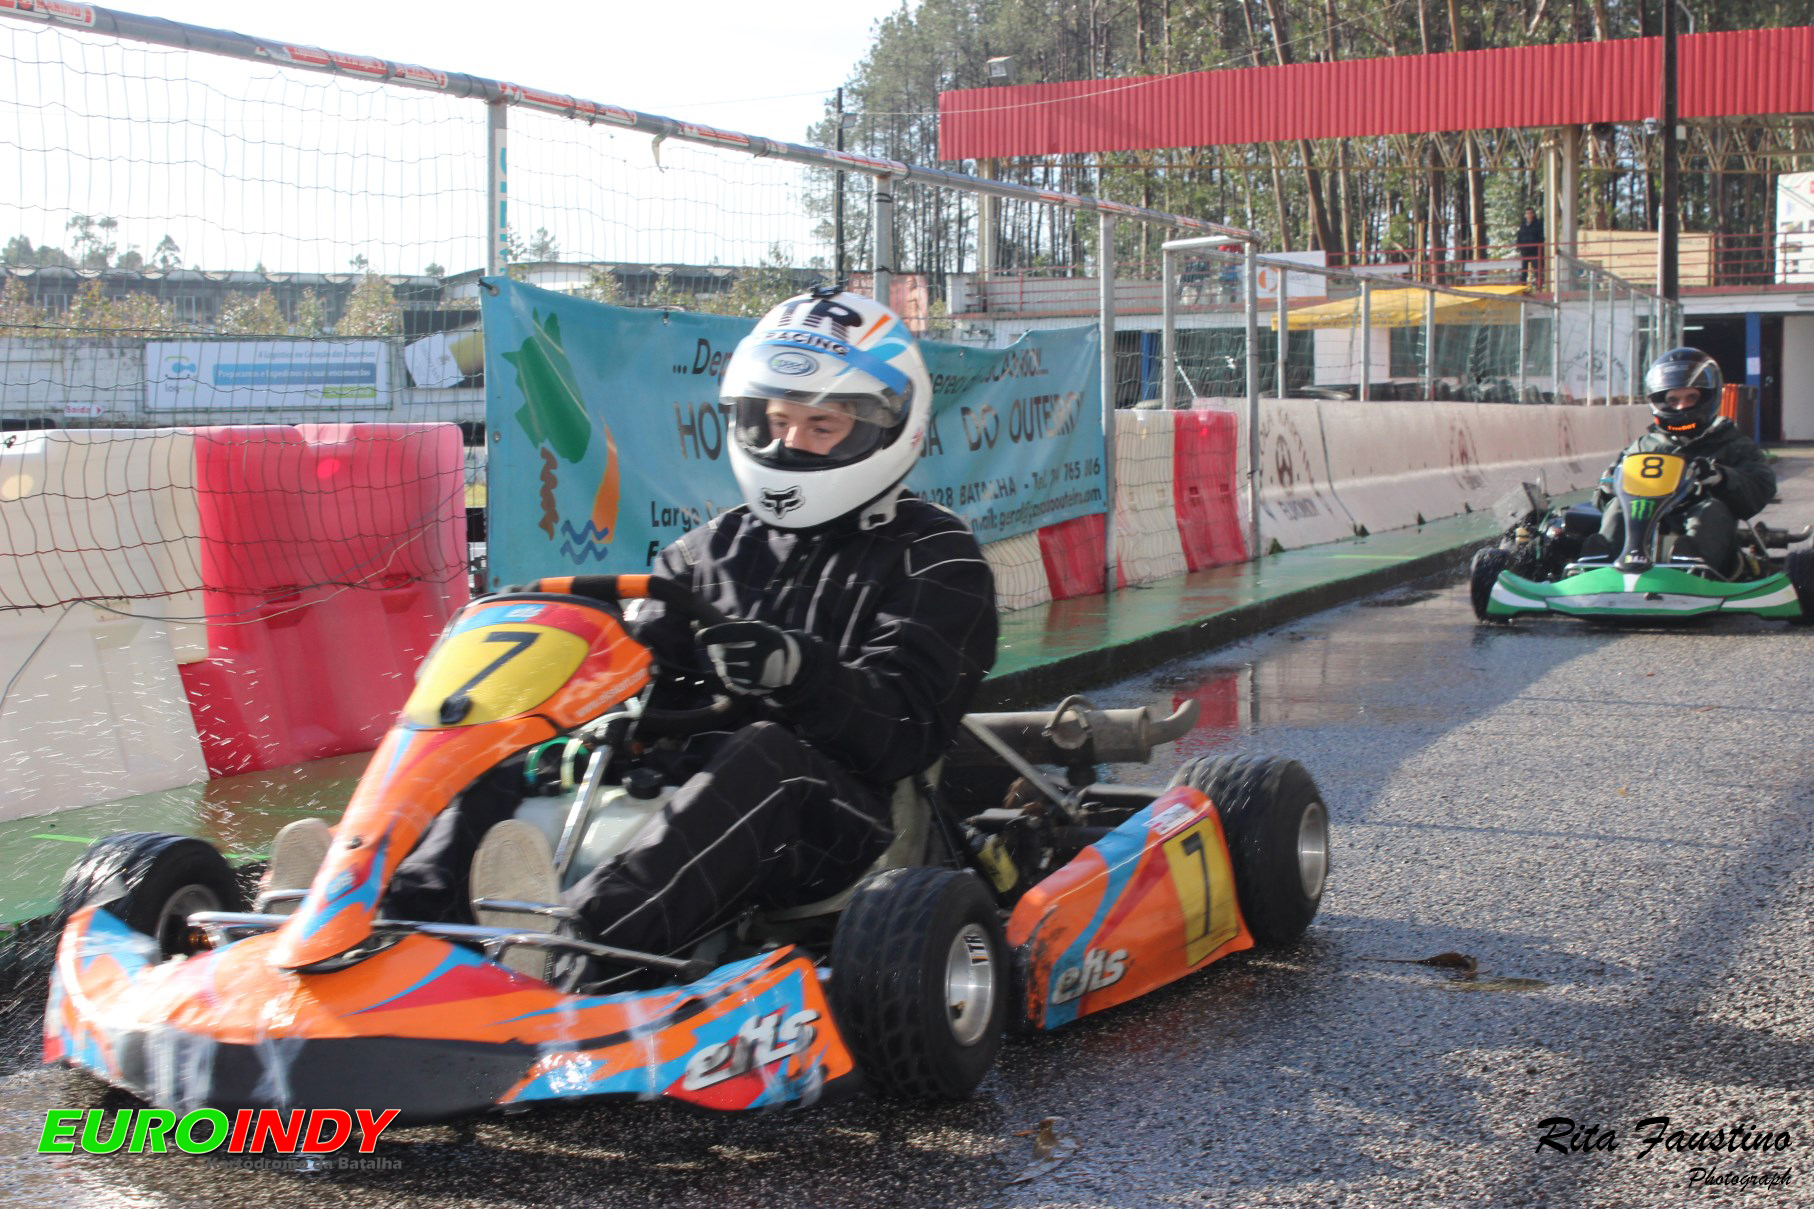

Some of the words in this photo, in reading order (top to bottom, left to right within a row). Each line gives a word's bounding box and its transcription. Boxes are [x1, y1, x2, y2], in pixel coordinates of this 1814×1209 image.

[1641, 456, 1664, 478] 8
[450, 631, 543, 703] 7
[1180, 831, 1211, 937] 7
